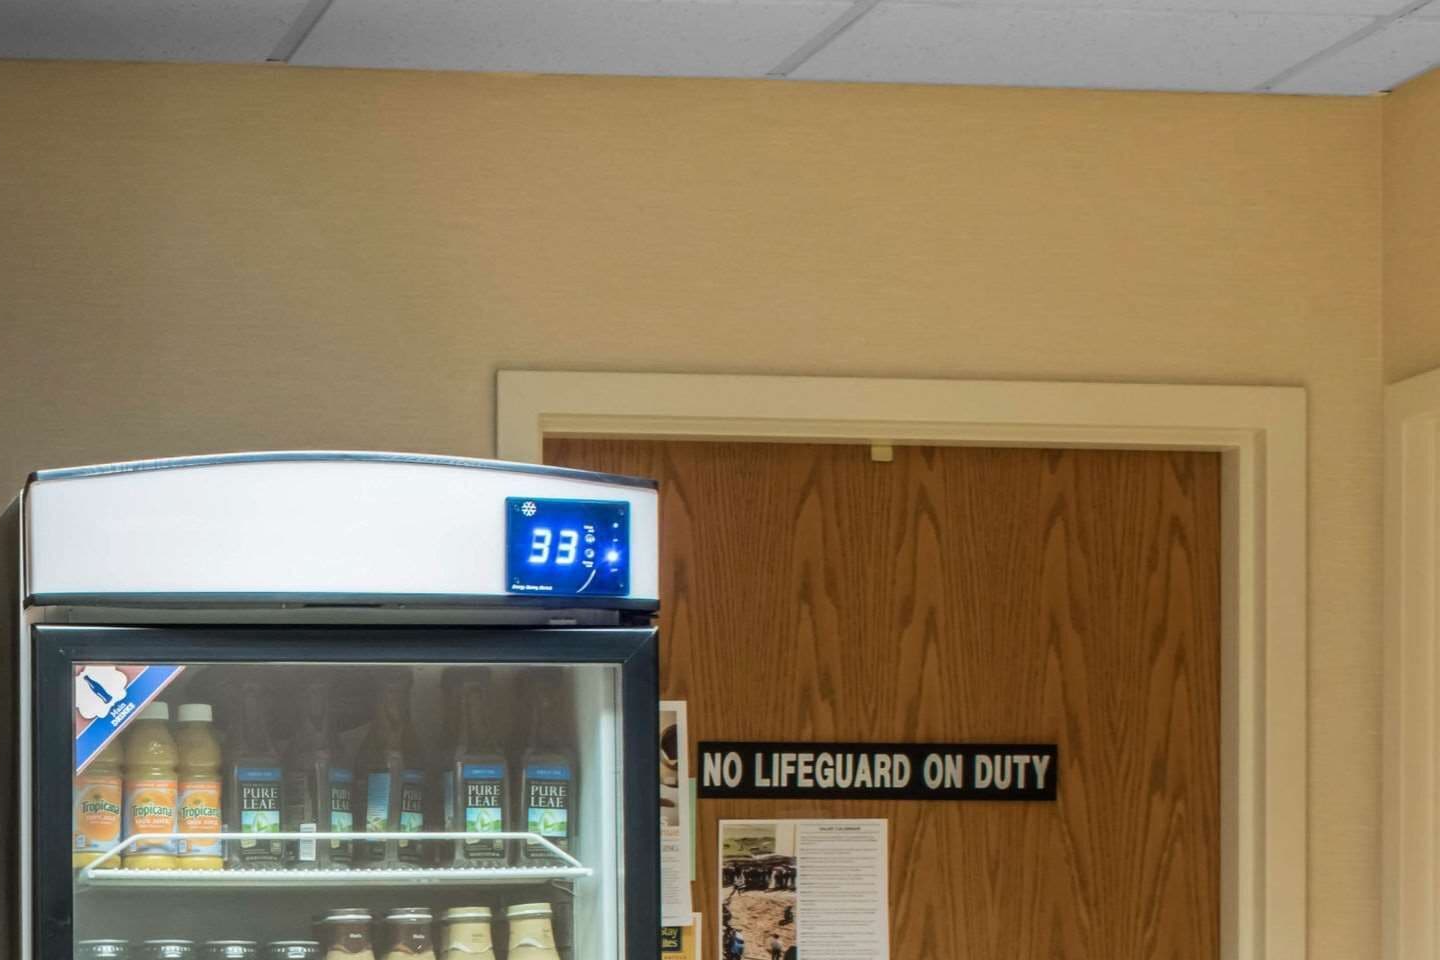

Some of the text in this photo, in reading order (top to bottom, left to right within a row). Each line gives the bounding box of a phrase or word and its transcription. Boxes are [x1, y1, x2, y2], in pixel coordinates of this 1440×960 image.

[527, 528, 579, 565] 33
[702, 752, 1051, 790] NO LIFEGUARD ON DUTY
[243, 786, 279, 798] PURE
[468, 785, 501, 796] PURE
[530, 785, 568, 797] PURE
[243, 798, 277, 809] LEAF
[468, 796, 499, 806] LEAF
[530, 797, 564, 808] LEAF
